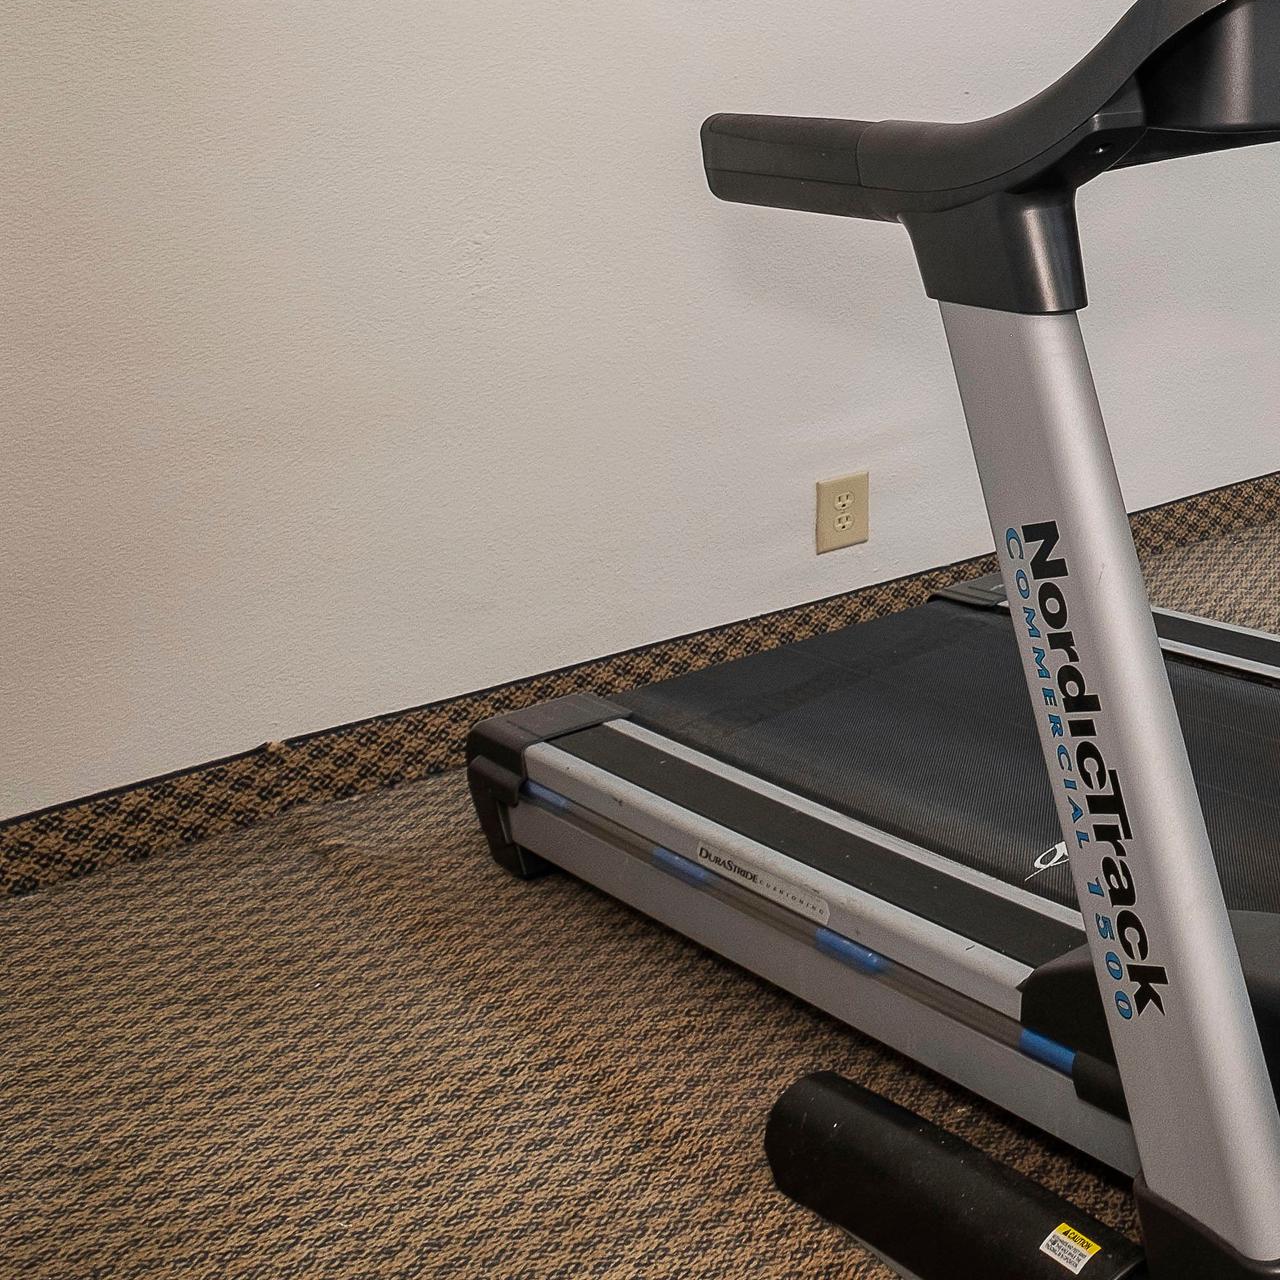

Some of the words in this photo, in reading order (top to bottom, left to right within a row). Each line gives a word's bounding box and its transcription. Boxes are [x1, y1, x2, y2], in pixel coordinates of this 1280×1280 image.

[1005, 527, 1090, 849] COMMERCIAL
[1086, 876, 1133, 1020] 1500
[1020, 520, 1169, 1017] NordicTrack
[1067, 1231, 1094, 1251] CAUTION
